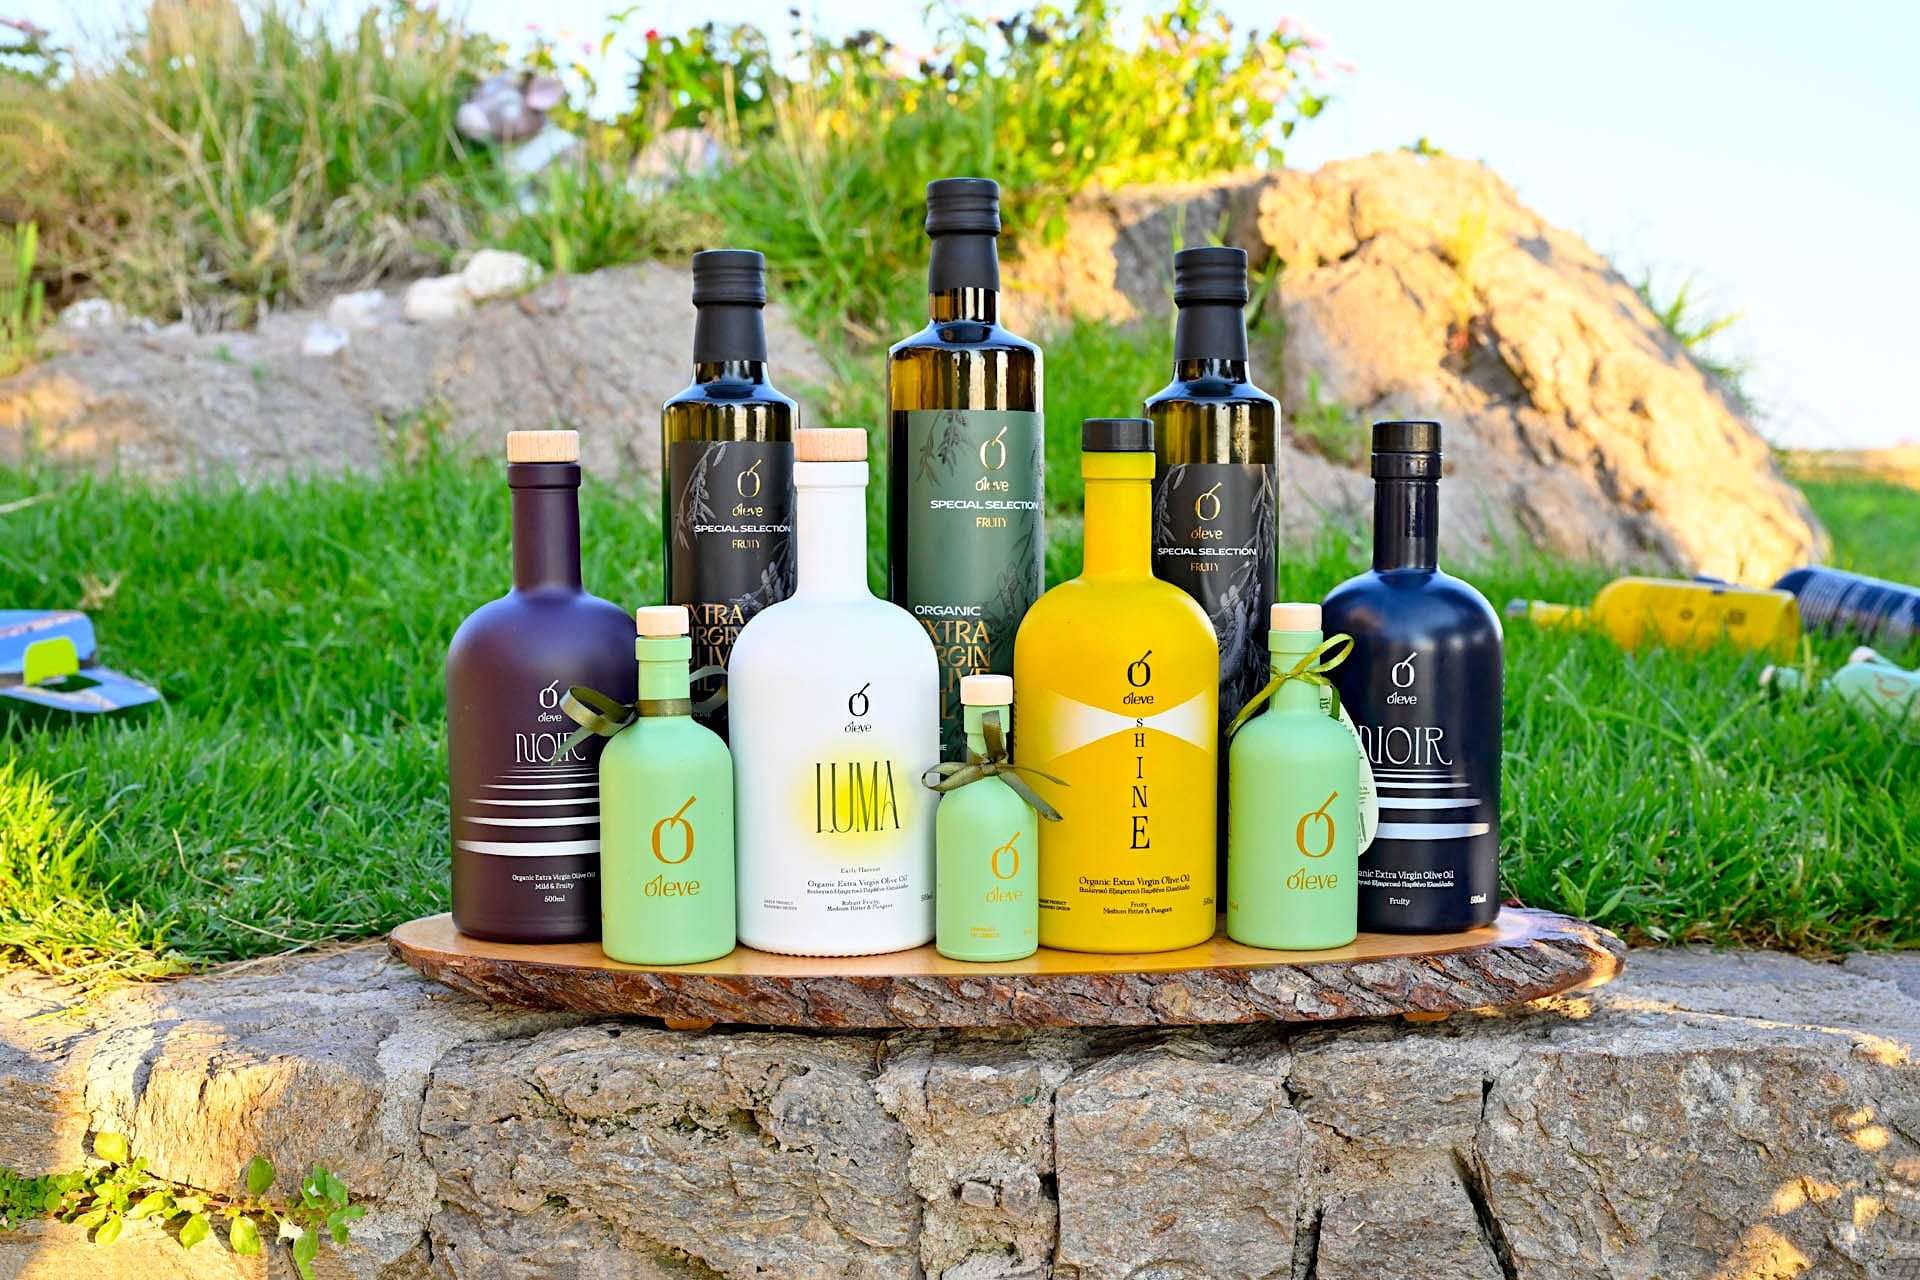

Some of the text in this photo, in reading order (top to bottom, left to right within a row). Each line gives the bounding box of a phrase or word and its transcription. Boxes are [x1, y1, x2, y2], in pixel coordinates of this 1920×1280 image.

[931, 500, 1038, 510] SPECIAL SELECTION
[694, 525, 791, 533] SPECIAL SELECTION
[1158, 547, 1257, 556] SPECIAL SELECTION
[681, 603, 745, 624] XTRA
[915, 605, 981, 616] ORGANIC
[920, 620, 990, 643] XTRA
[1359, 725, 1452, 765] NOIR
[816, 760, 900, 834] LUMA
[512, 874, 534, 882] Organic
[1358, 869, 1454, 880] anic Extra Virgin Olive Oil
[807, 880, 835, 888] Organic
[859, 879, 880, 887] Virgin
[1079, 876, 1111, 887] Organic
[1112, 877, 1135, 886] Extra
[1137, 877, 1160, 887] Virgin
[1161, 876, 1180, 884] Olive
[1389, 897, 1410, 906] Fruity
